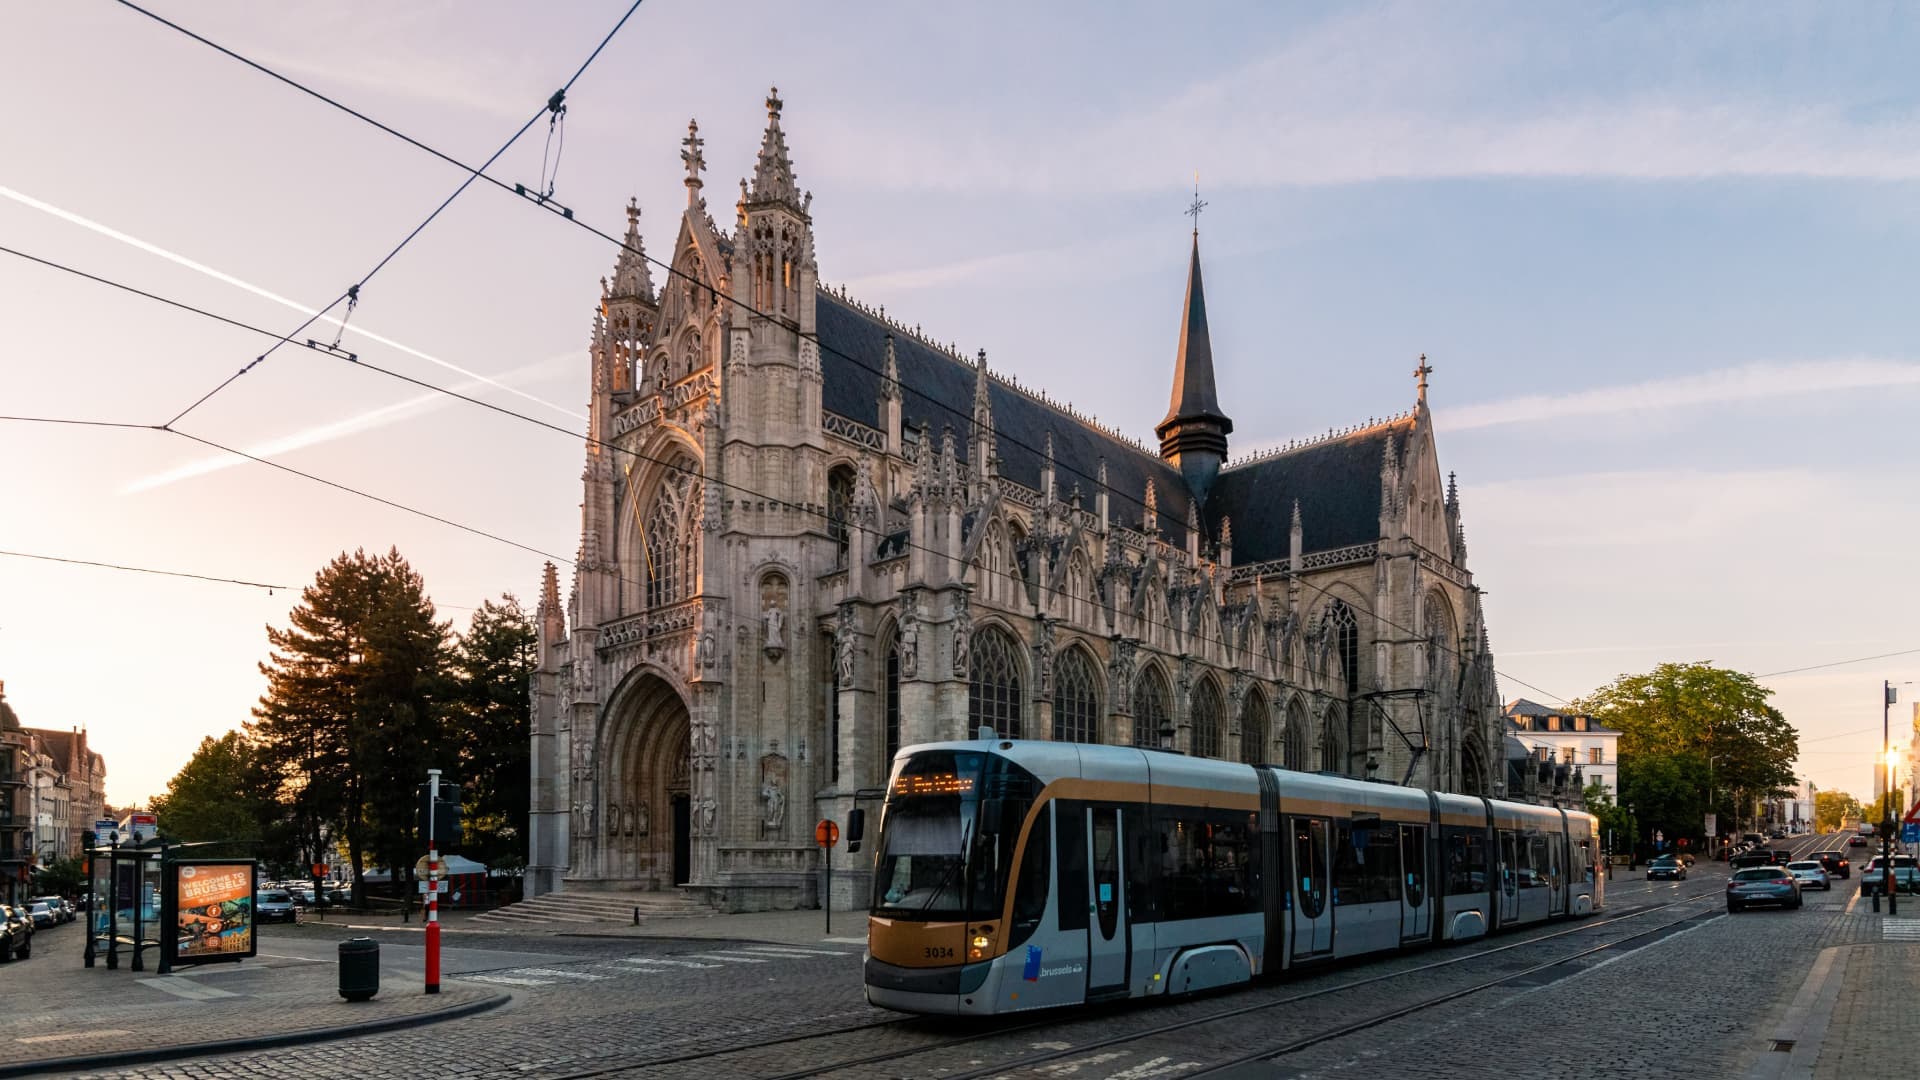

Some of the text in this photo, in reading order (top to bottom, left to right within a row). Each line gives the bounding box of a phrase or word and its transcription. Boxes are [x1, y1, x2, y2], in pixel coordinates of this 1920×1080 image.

[182, 872, 245, 890] WELCOME TO
[184, 879, 247, 898] BRUSSELS
[924, 946, 954, 959] 3034
